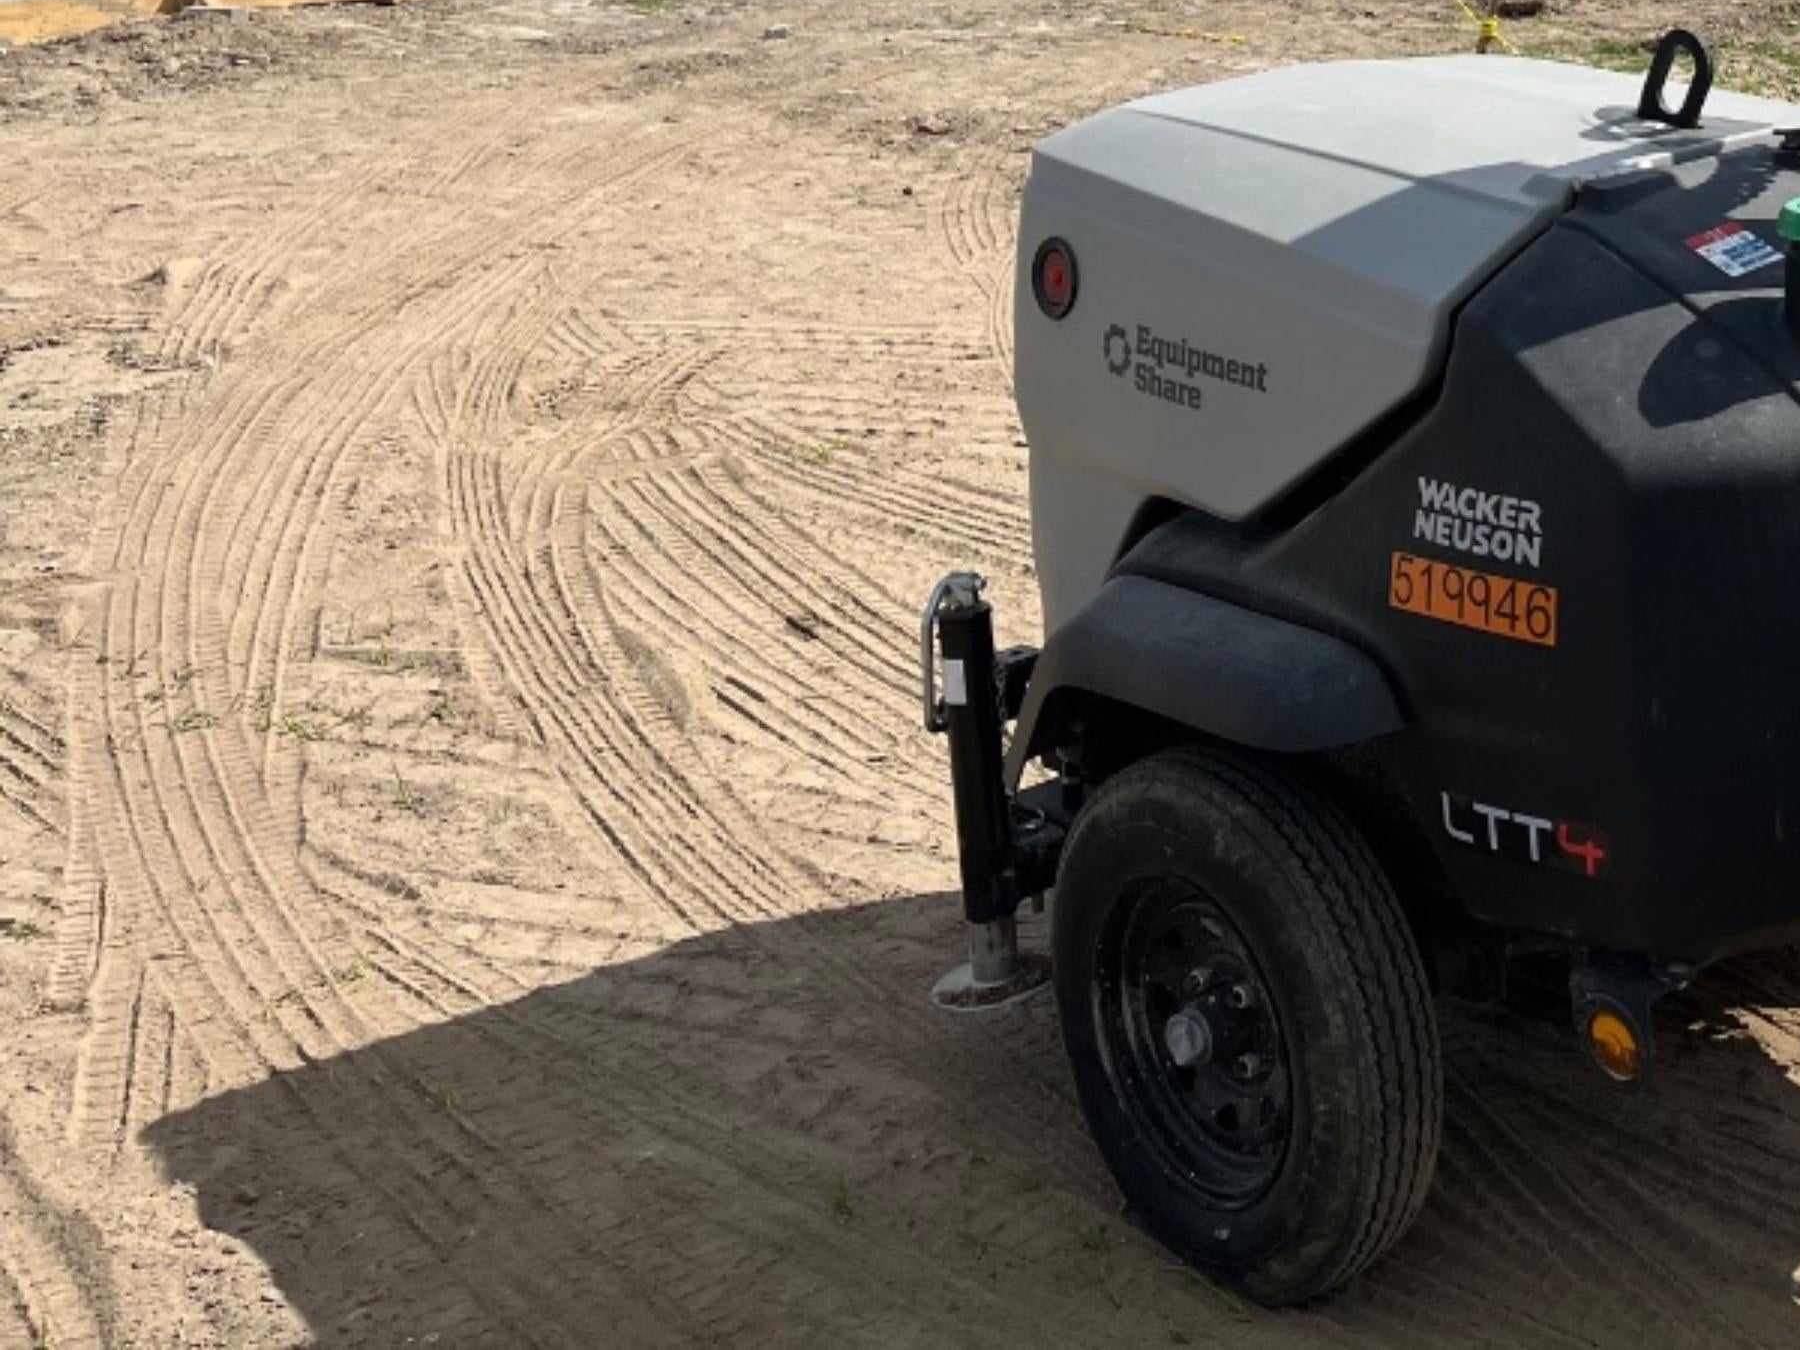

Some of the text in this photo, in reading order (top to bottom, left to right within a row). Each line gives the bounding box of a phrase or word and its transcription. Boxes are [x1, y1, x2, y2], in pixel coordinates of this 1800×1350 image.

[1135, 325, 1267, 394] Equipment
[1135, 363, 1201, 410] Share
[1417, 476, 1542, 531] WACKER
[1414, 508, 1541, 568] NEUSON
[1392, 558, 1553, 640] 519946
[1441, 792, 1606, 878] LTT4
